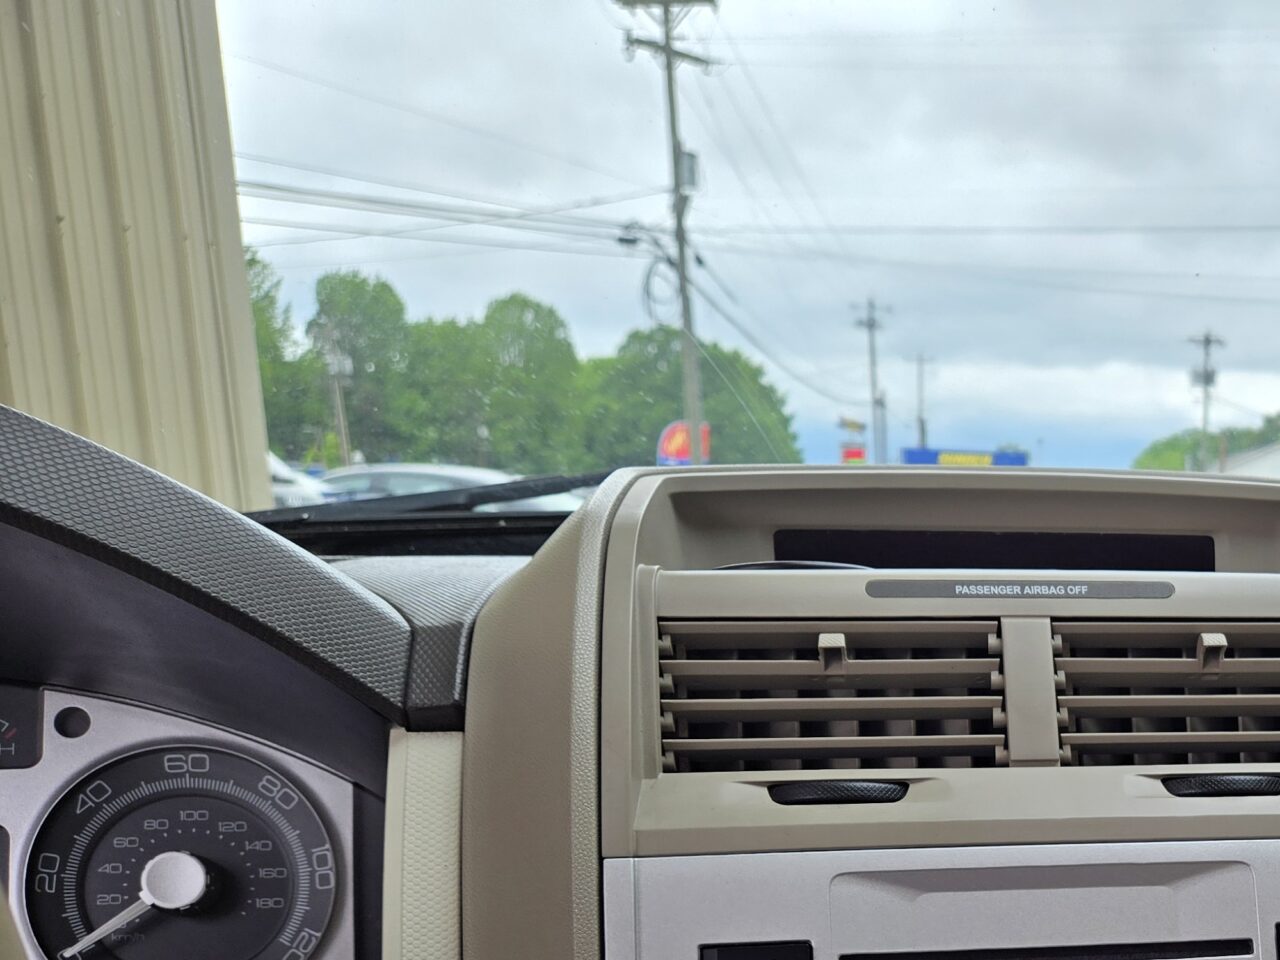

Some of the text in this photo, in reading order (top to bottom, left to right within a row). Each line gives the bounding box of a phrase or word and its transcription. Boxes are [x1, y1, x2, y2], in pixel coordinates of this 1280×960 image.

[954, 584, 1088, 595] PASSENGER AIRBAG OFF
[164, 753, 209, 773] 60
[76, 780, 112, 814] 40
[258, 775, 298, 810] 80
[179, 810, 209, 821] 100
[143, 818, 169, 830] 80
[218, 821, 248, 833] 120
[113, 836, 139, 849] 60
[245, 840, 272, 851] 140
[35, 852, 60, 893] 20
[97, 863, 122, 874] 40
[258, 867, 288, 879] 160
[311, 844, 336, 890] 100
[96, 893, 122, 905] 20
[255, 897, 285, 909] 180
